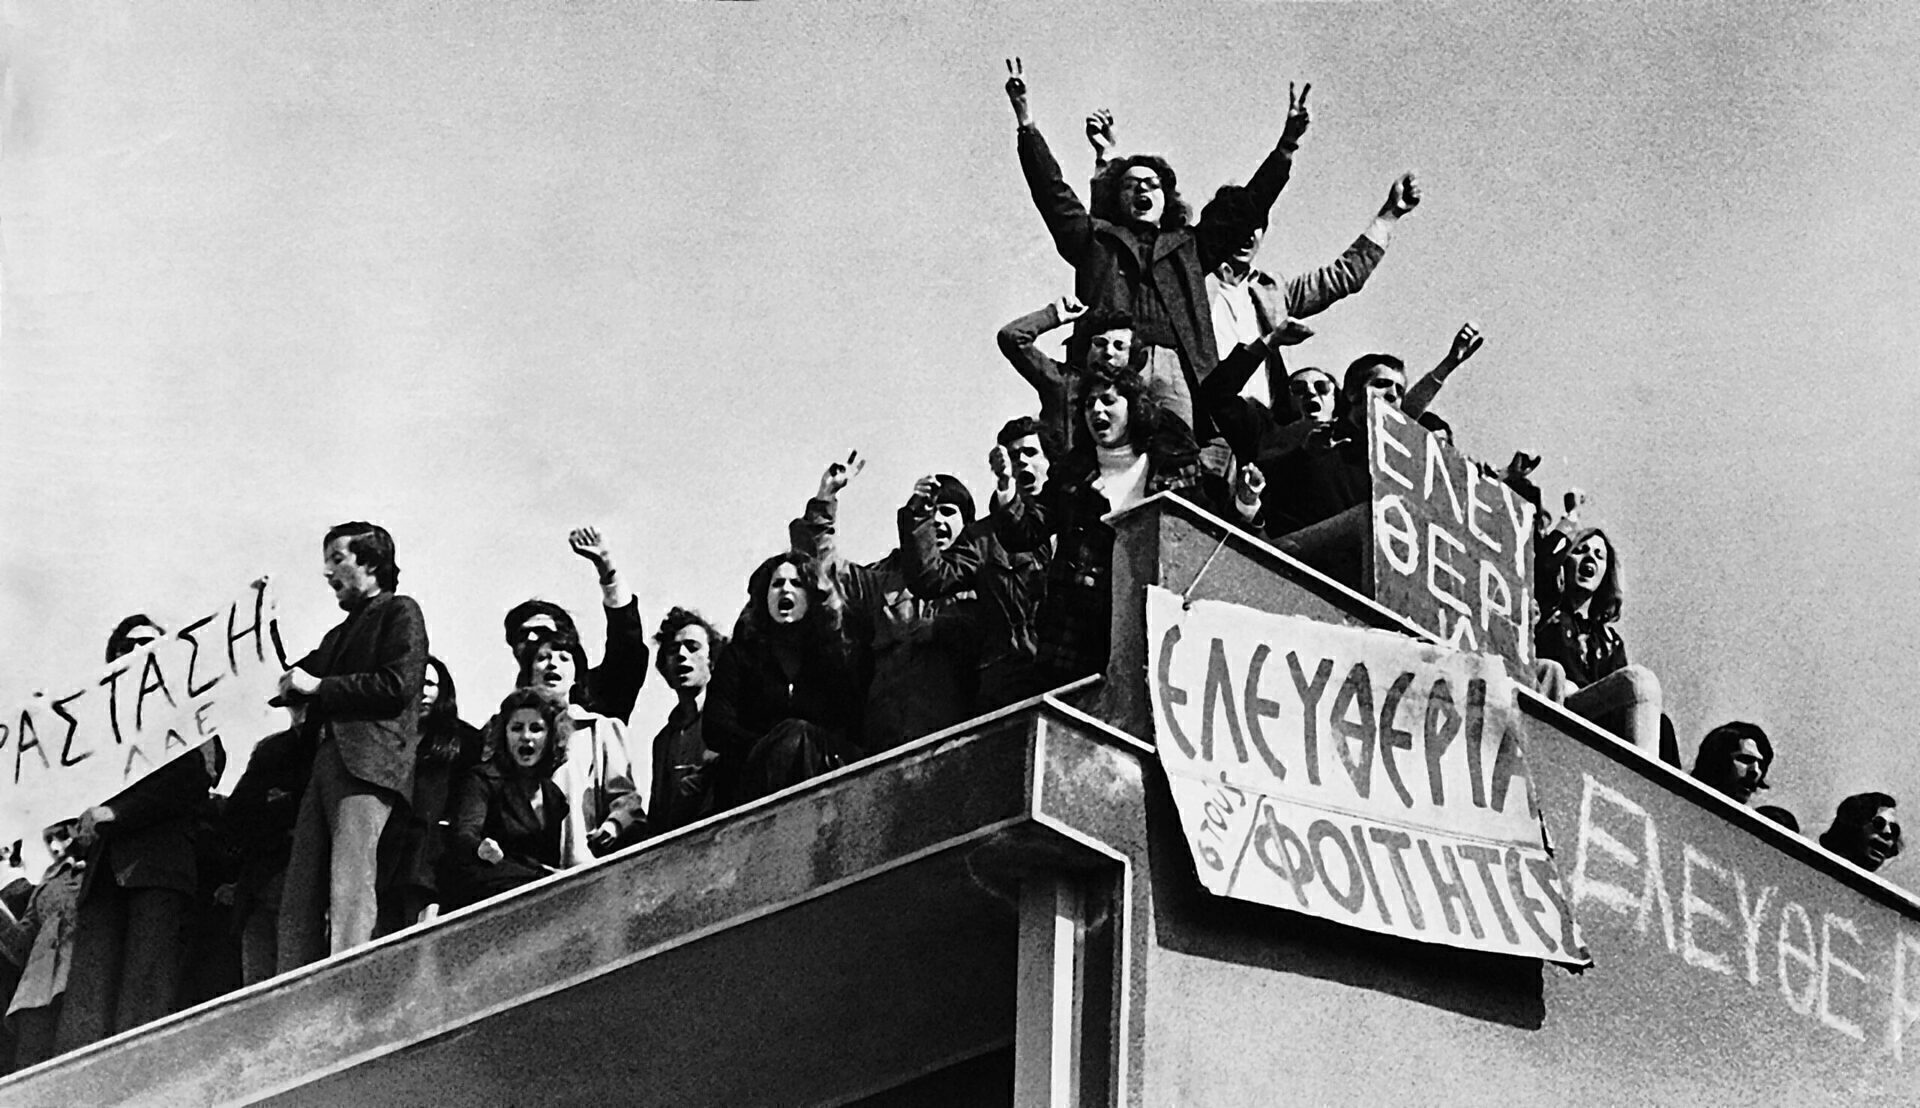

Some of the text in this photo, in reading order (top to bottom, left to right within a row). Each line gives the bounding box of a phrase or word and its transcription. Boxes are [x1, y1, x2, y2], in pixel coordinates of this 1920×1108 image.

[1375, 398, 1538, 579] ΕΛΕΥ
[1158, 624, 1540, 820] ΕΛΕΥΘΕΡΙΑ
[1254, 804, 1590, 960] ΦΟΙΤΗΤΕΣ
